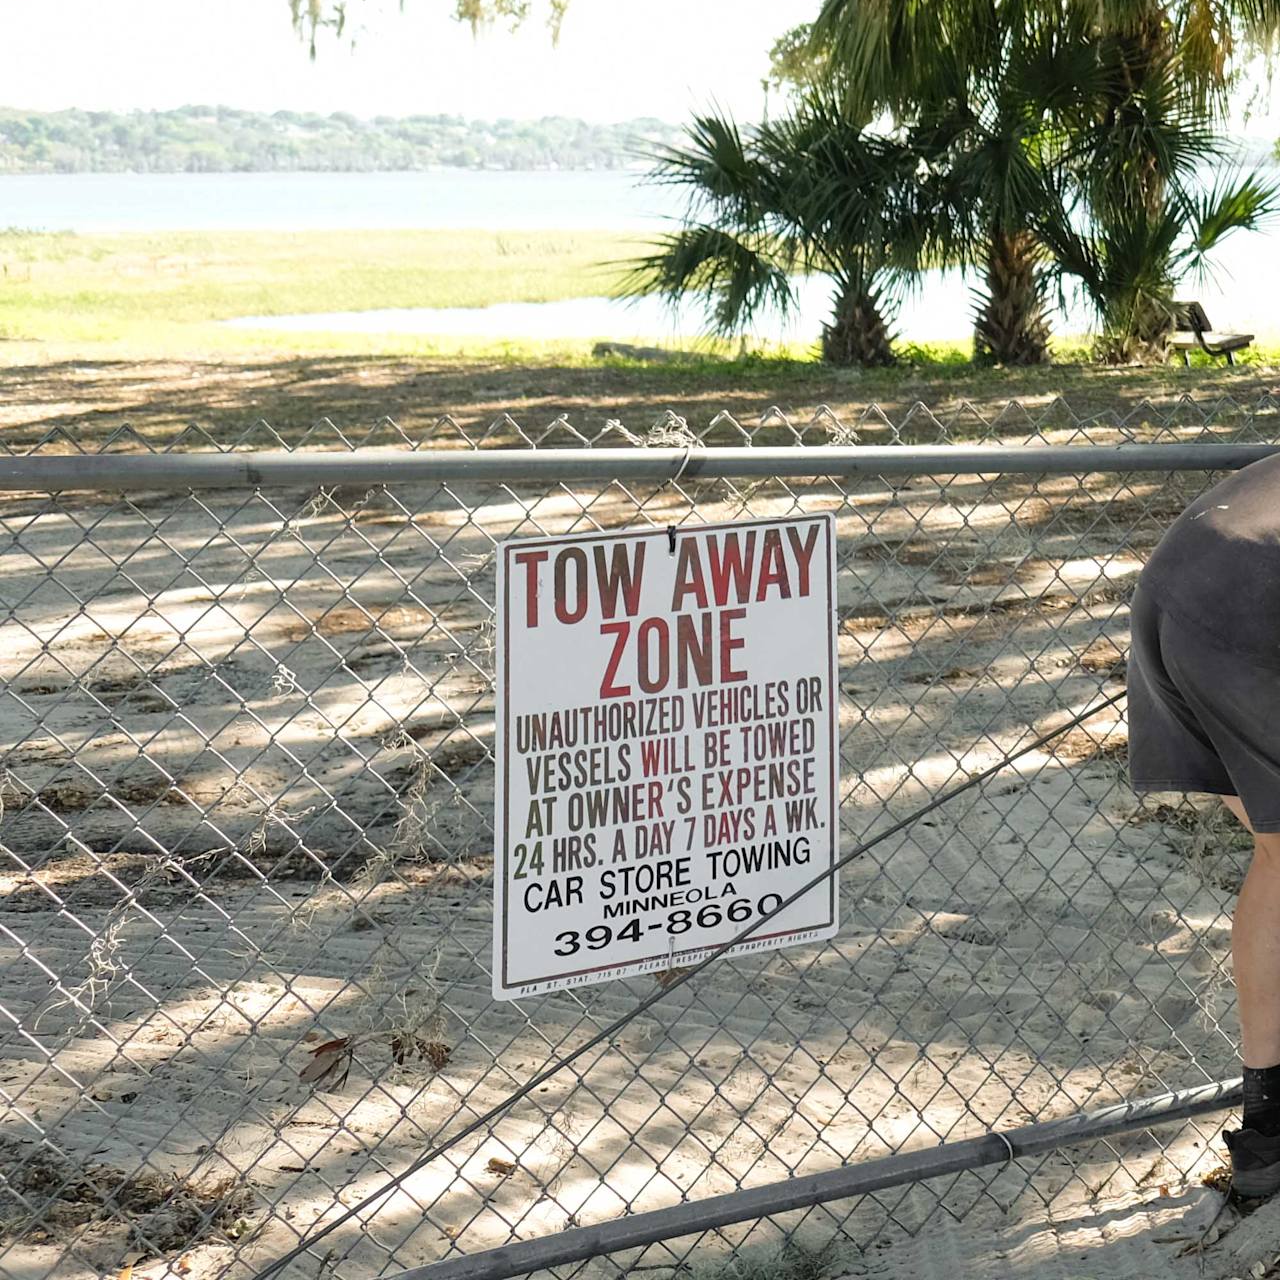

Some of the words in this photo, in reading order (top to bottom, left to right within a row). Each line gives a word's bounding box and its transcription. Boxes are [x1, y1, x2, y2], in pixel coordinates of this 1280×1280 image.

[514, 540, 647, 628] TOW
[670, 523, 821, 612] AWAY
[600, 607, 748, 700] ZONE
[516, 695, 684, 754] UNAUTHORIZED
[692, 681, 789, 729] VEHICLES
[796, 676, 823, 716] OR
[526, 743, 631, 795] VESSELS
[640, 735, 696, 778] WILL
[704, 729, 731, 769] BE
[740, 717, 815, 763] TOWED
[525, 796, 557, 838] AT
[568, 776, 691, 831] OWNER'S
[702, 757, 816, 811] EXPENSE
[513, 841, 545, 880] 24
[553, 832, 604, 874] HRS.
[612, 828, 627, 864] A
[635, 819, 676, 860] DAY
[684, 816, 696, 851] 7
[704, 807, 755, 848] DAYS
[763, 804, 777, 838] A
[785, 796, 826, 834] WK.
[524, 876, 583, 913] CAR
[599, 856, 691, 900] STORE
[706, 836, 810, 880] TOWING
[554, 892, 785, 958] 394-8660
[603, 883, 737, 920] MINNEOLA
